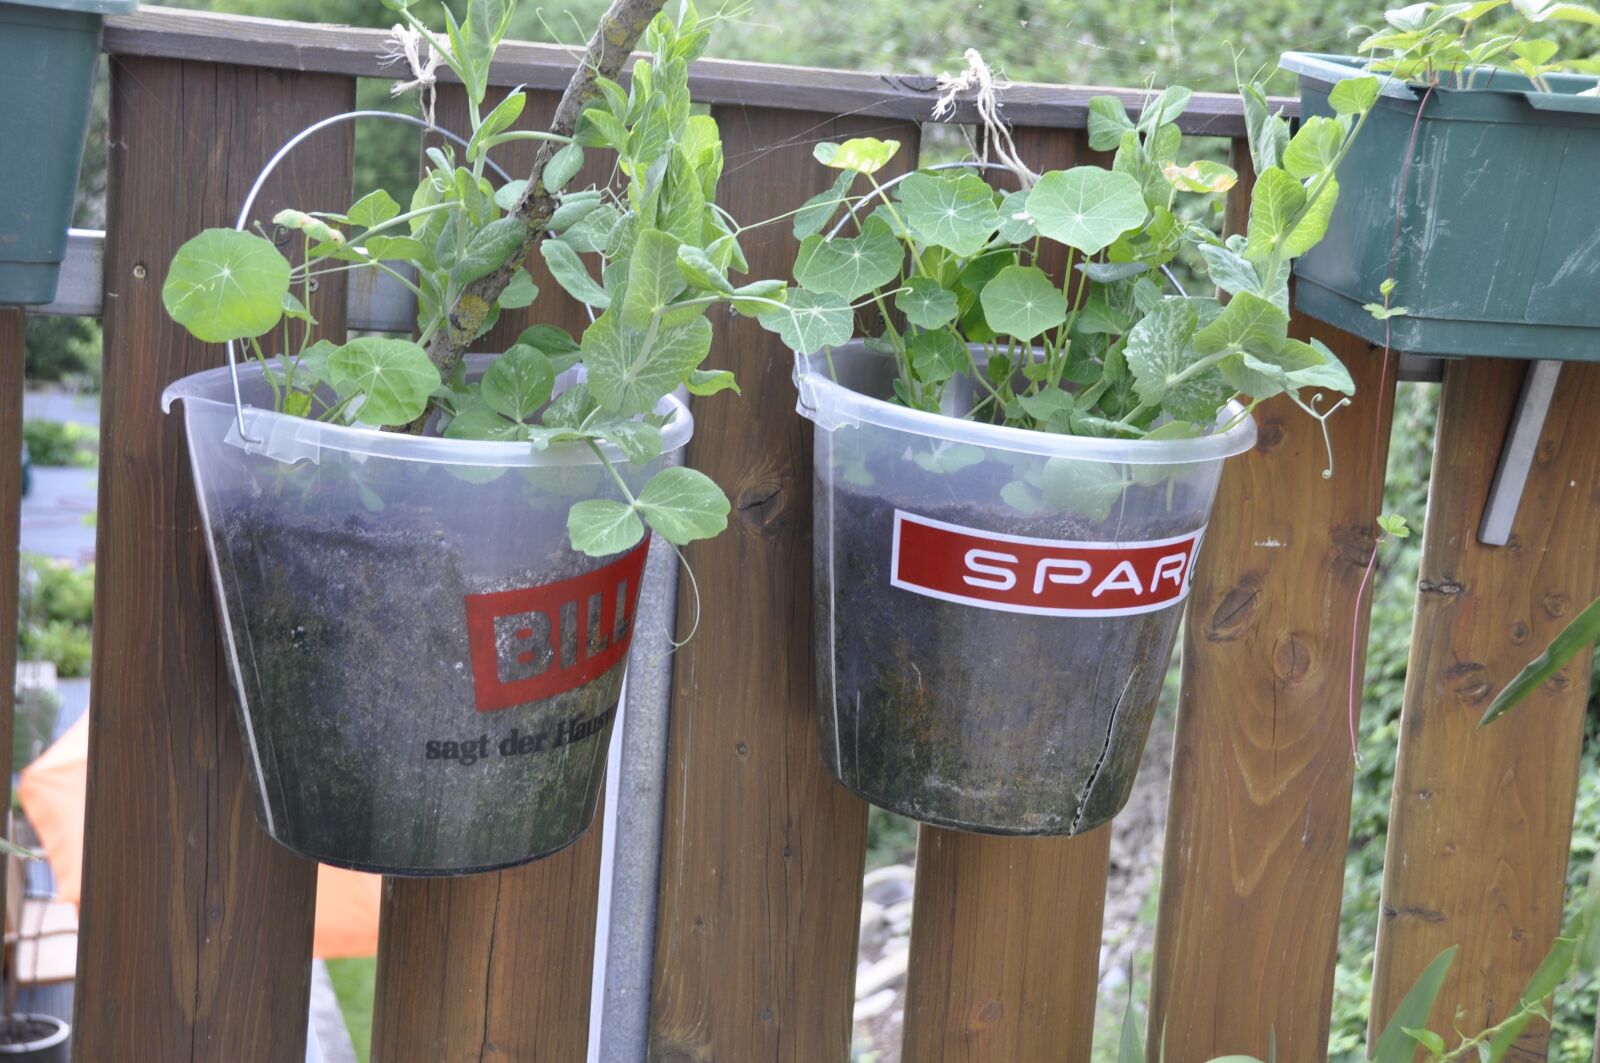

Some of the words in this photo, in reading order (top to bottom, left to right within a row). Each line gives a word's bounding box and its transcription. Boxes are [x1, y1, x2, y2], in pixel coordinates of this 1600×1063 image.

[962, 548, 1187, 598] SPAR
[425, 732, 490, 767] sagt
[500, 728, 549, 757] der
